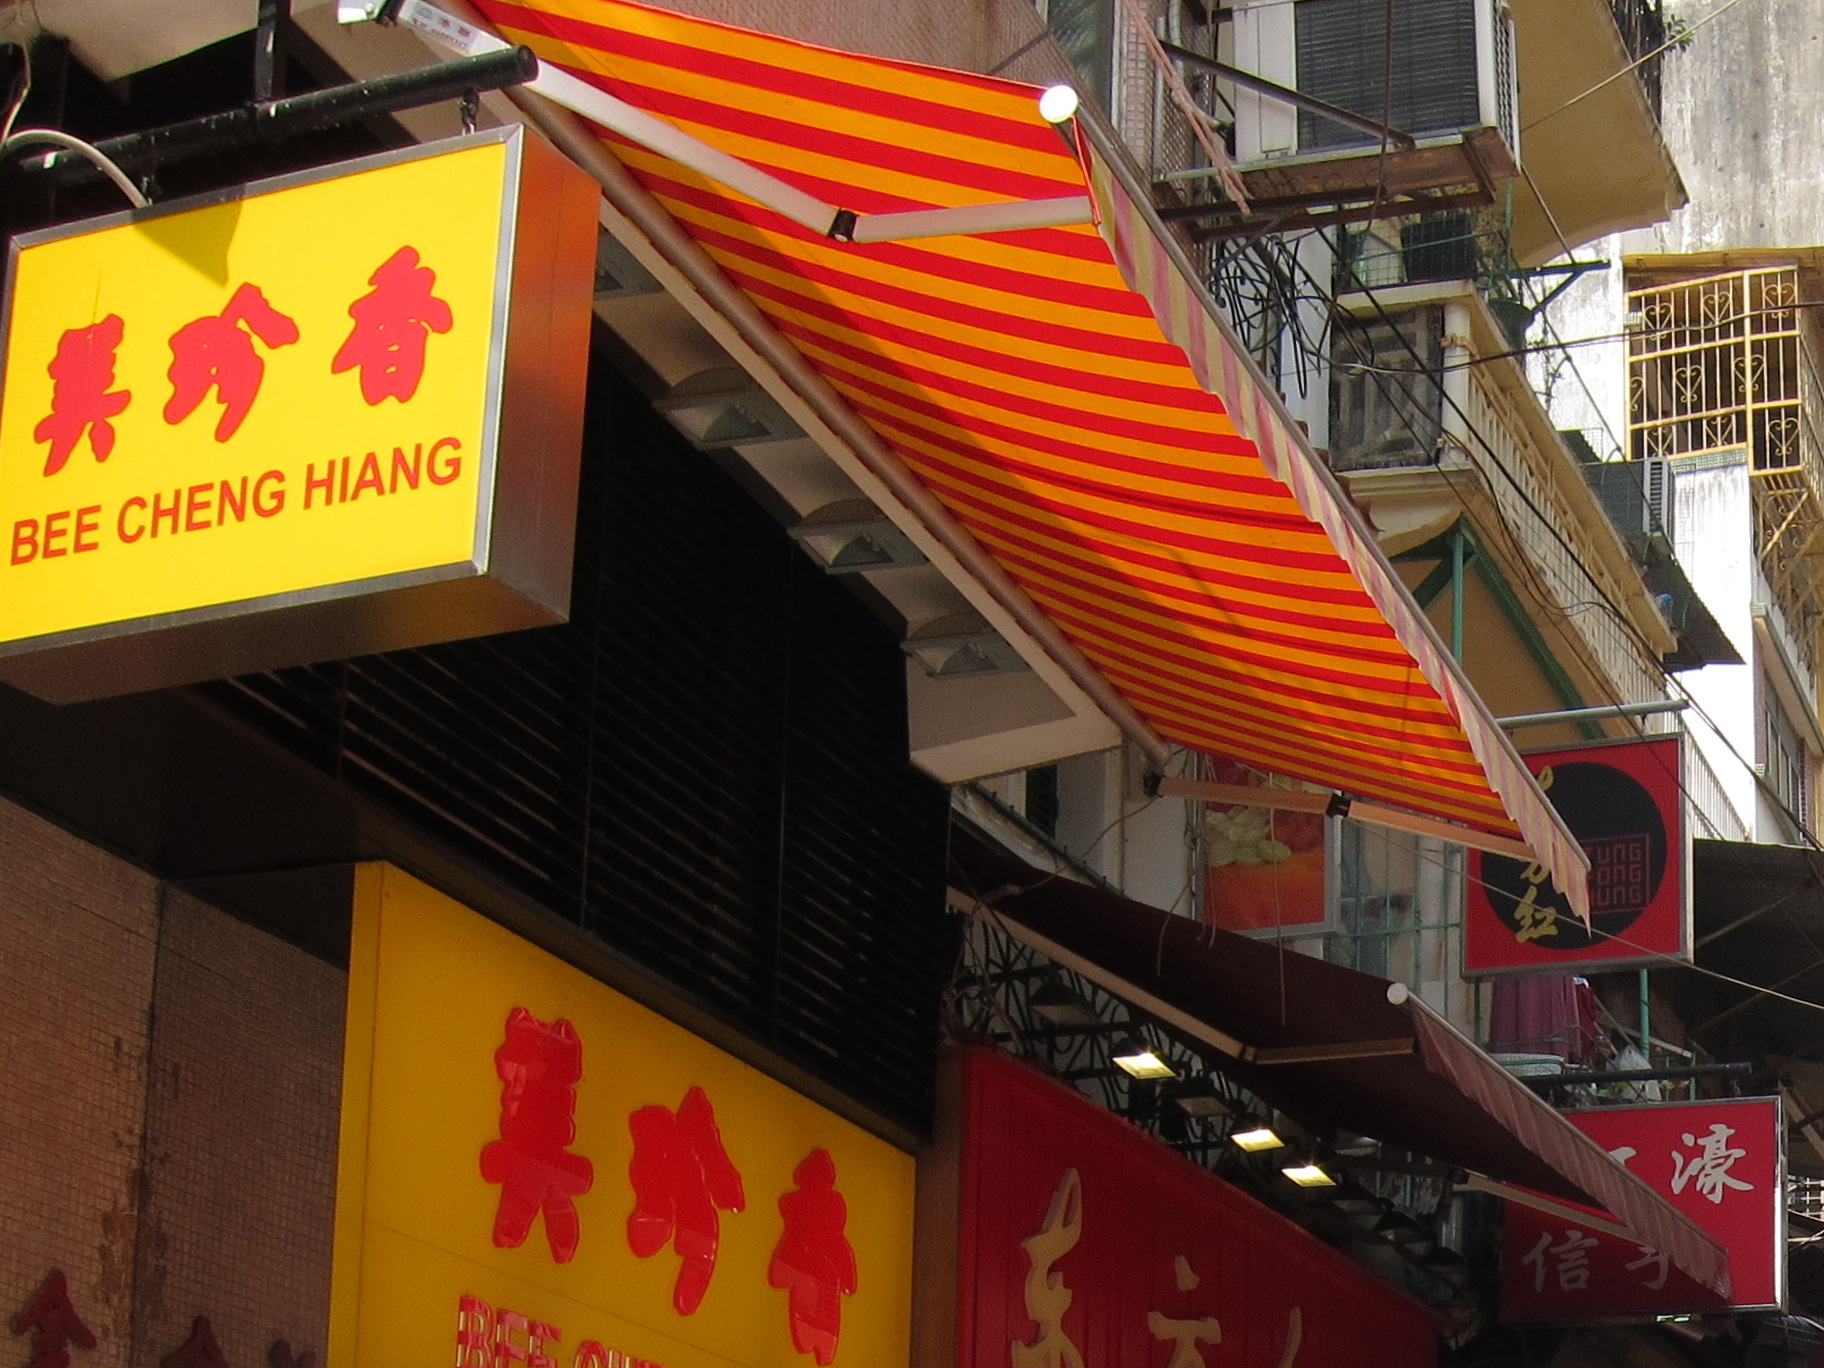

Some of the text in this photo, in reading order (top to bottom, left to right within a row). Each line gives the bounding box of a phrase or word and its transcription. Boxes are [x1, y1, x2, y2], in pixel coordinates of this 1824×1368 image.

[10, 436, 462, 566] BEE CHENG HIANG
[1589, 864, 1642, 886] ONG
